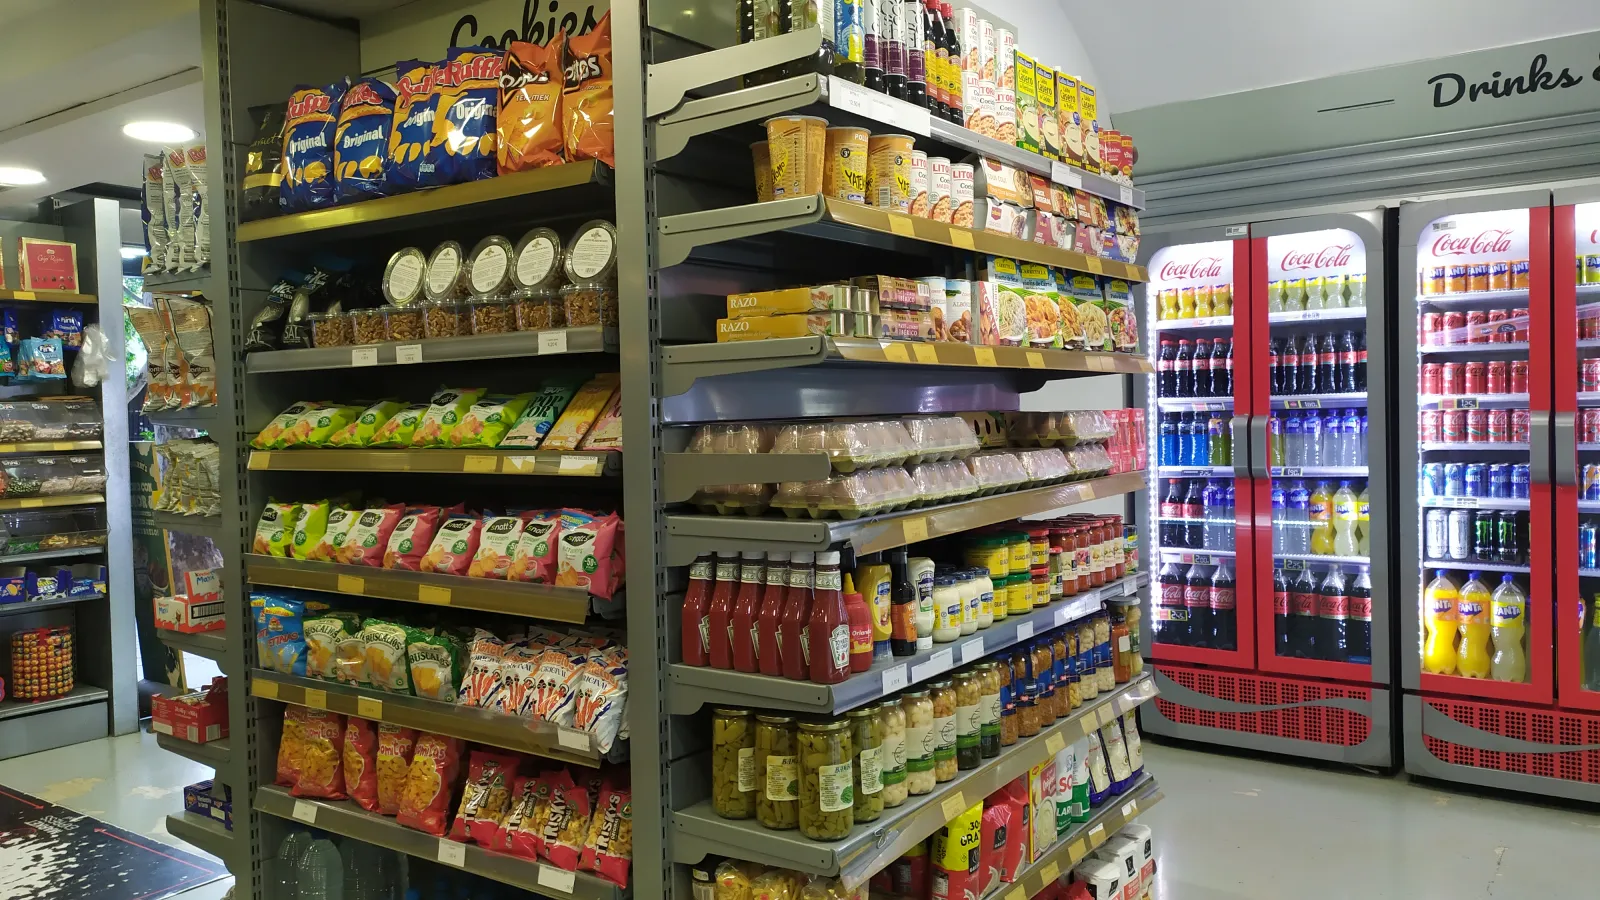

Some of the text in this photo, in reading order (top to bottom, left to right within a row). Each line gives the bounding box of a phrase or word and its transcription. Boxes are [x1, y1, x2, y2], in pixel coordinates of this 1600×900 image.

[1427, 53, 1584, 108] Drinks
[1060, 90, 1077, 103] Casero
[289, 131, 328, 158] Original
[343, 125, 384, 149] Original
[1431, 228, 1515, 257] Coca-Cola
[1160, 256, 1223, 281] Coca-Cola
[1281, 244, 1355, 271] Coca-Cola
[730, 297, 757, 309] RAZO
[720, 321, 749, 333] RAZO
[1458, 601, 1483, 612] FANTA
[1495, 605, 1521, 616] FANTA
[544, 787, 567, 845] TRISKYS
[595, 794, 621, 856] TRISKYS
